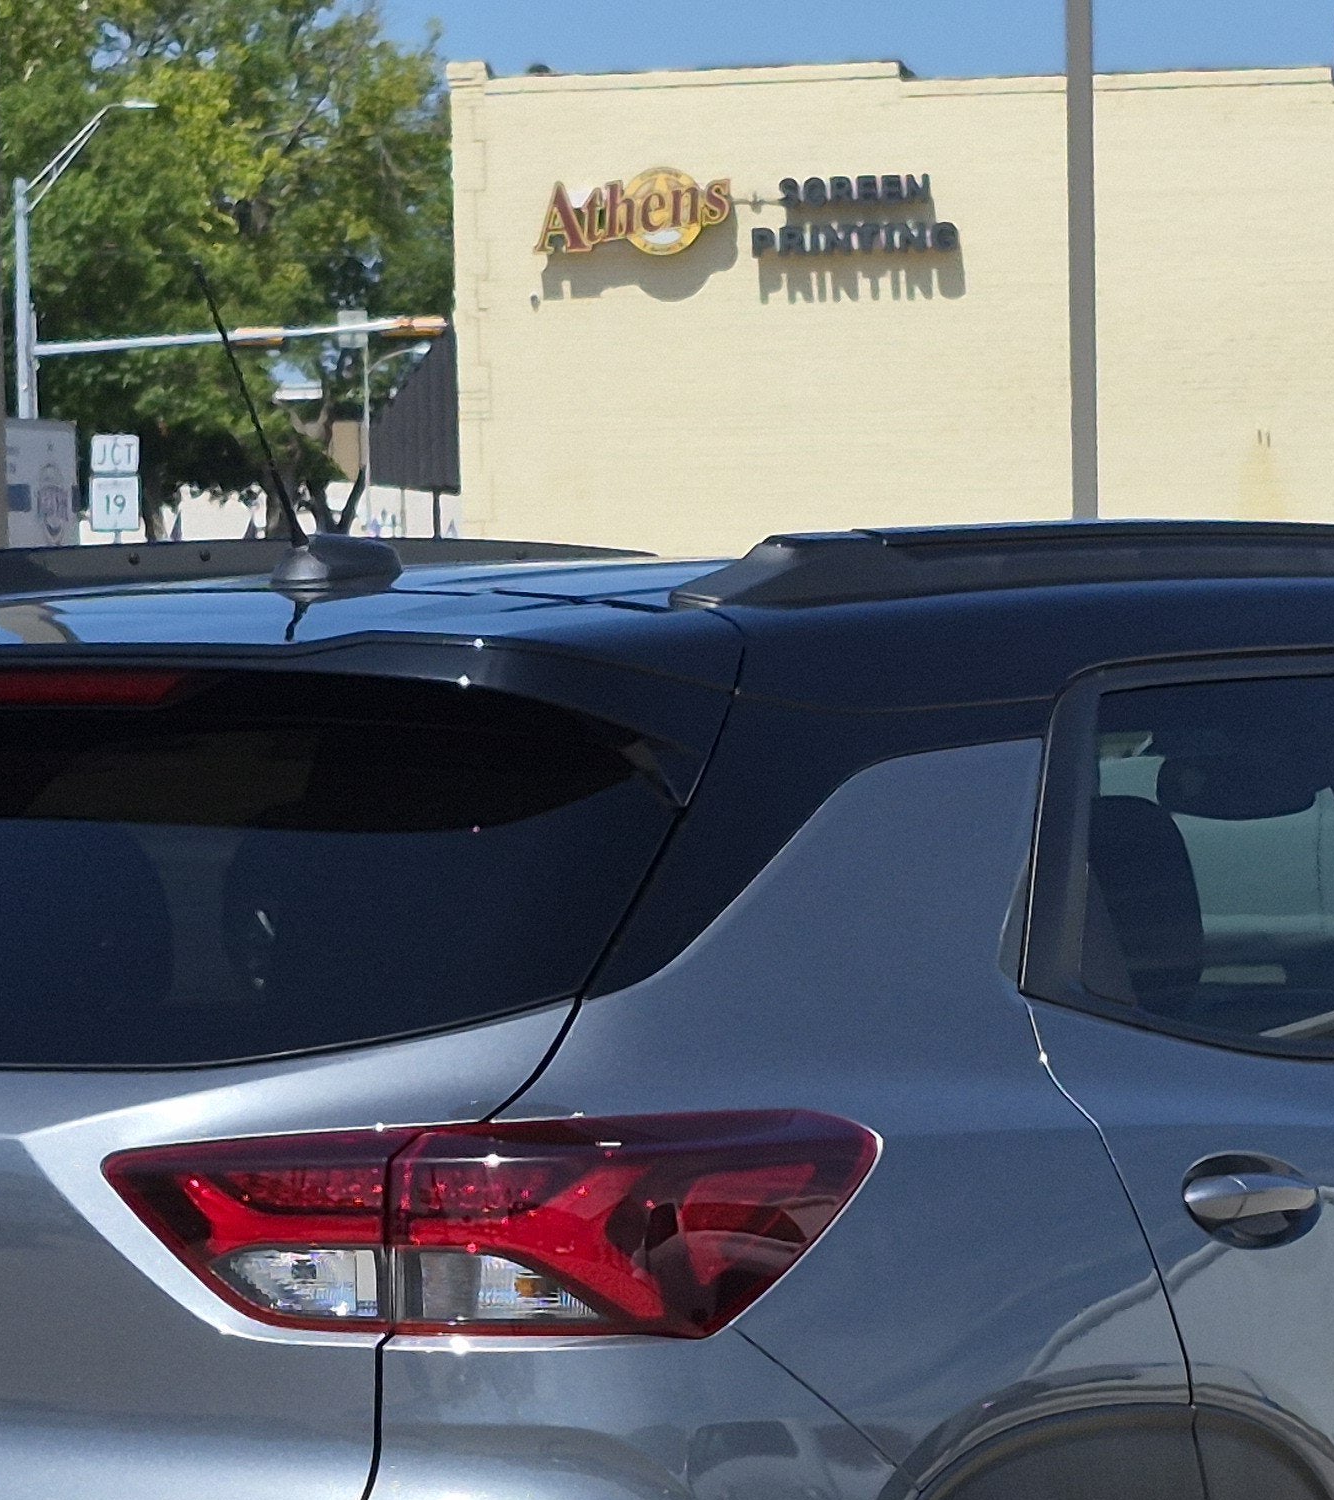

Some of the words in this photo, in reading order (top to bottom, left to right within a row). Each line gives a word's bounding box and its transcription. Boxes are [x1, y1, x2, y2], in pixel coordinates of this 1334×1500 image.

[778, 173, 931, 208] SCREEN
[533, 177, 731, 255] Athens
[751, 221, 959, 258] PRINTING
[97, 442, 134, 465] JCT
[105, 494, 126, 515] 19
